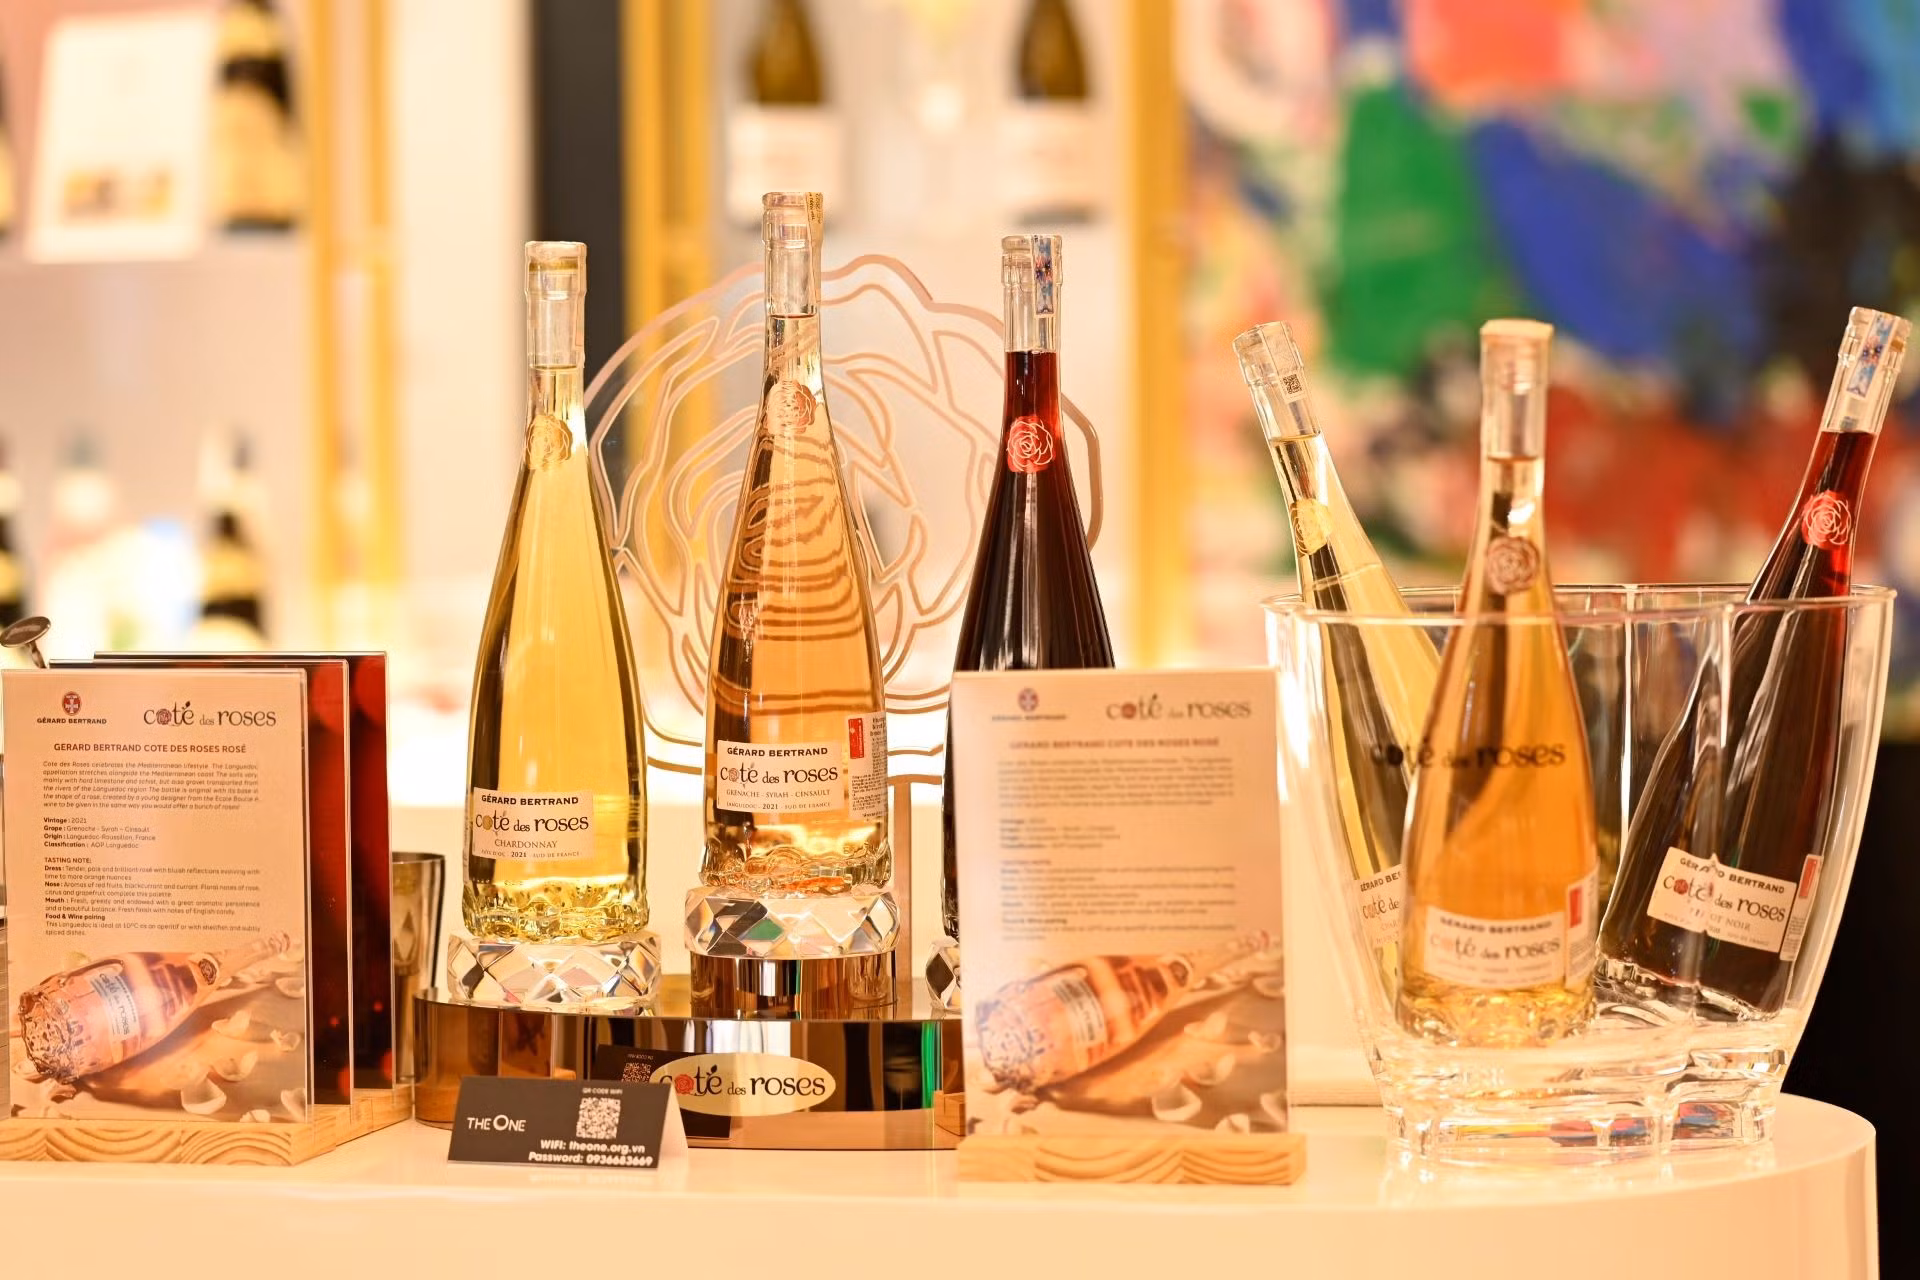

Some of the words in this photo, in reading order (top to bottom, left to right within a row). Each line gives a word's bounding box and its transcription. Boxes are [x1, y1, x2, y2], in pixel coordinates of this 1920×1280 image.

[37, 716, 66, 724] GÉRARD
[217, 710, 276, 726] roses
[54, 743, 91, 751] GERARD
[93, 743, 141, 752] BERTRAND
[143, 744, 168, 753] COTE
[170, 744, 188, 753] DES
[190, 745, 220, 753] ROSES
[222, 743, 247, 753] ROSÉ
[727, 746, 765, 757] GÉRARD
[769, 747, 828, 757] BERTRAND
[1477, 745, 1566, 768] roses
[762, 771, 780, 784] des
[783, 766, 838, 784] roses
[481, 794, 517, 805] GÉRARD
[520, 797, 579, 806] BERTRAND
[795, 789, 831, 798] CINSAULT
[513, 820, 531, 832] des
[534, 816, 589, 832] roses
[494, 839, 558, 849] CHARDONNAY
[1728, 873, 1785, 894] BERTRAND
[1714, 894, 1733, 909] des
[1737, 898, 1786, 923] roses
[1505, 937, 1560, 959] roses
[727, 1085, 747, 1096] des
[749, 1076, 826, 1096] roses
[467, 1117, 491, 1131] THE
[493, 1115, 526, 1132] ONE
[569, 1141, 645, 1155] theone.org.vn
[528, 1151, 583, 1163] Password:
